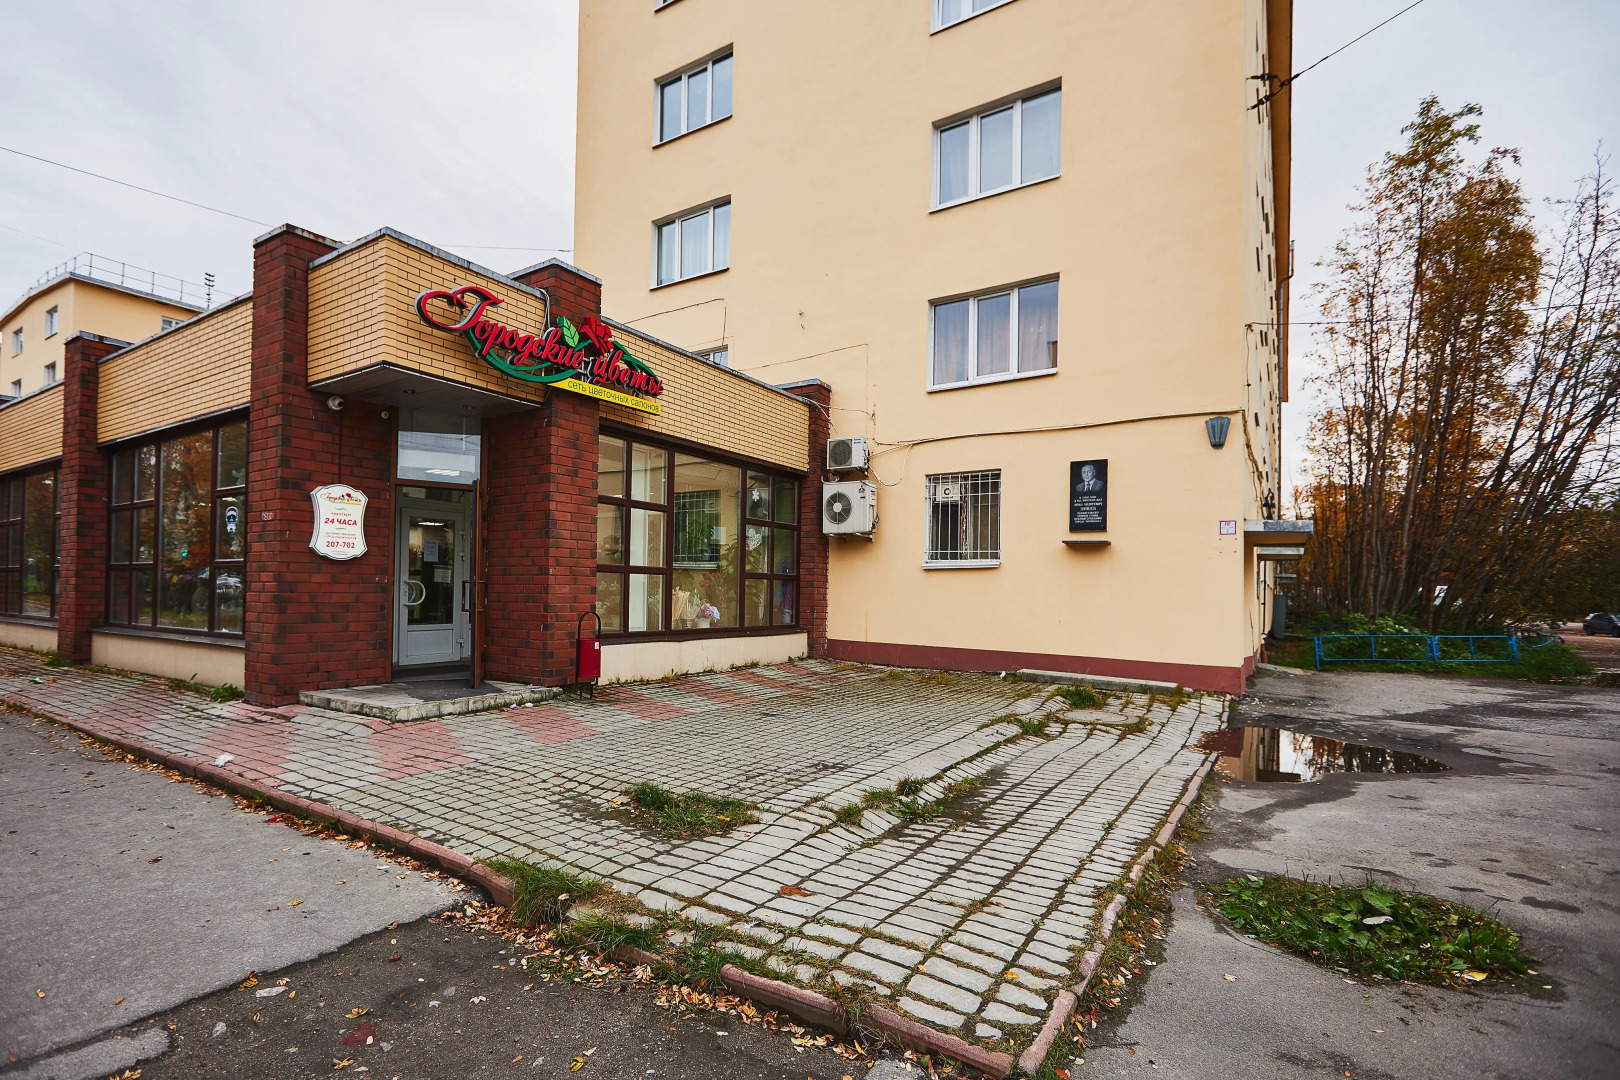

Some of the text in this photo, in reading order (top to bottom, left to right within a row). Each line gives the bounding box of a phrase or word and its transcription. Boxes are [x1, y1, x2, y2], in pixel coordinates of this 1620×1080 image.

[415, 286, 663, 397] Городские цветы
[567, 380, 660, 413] сеть цветочных салонов
[336, 518, 358, 526] ЧАСА
[326, 540, 355, 549] 207-702
